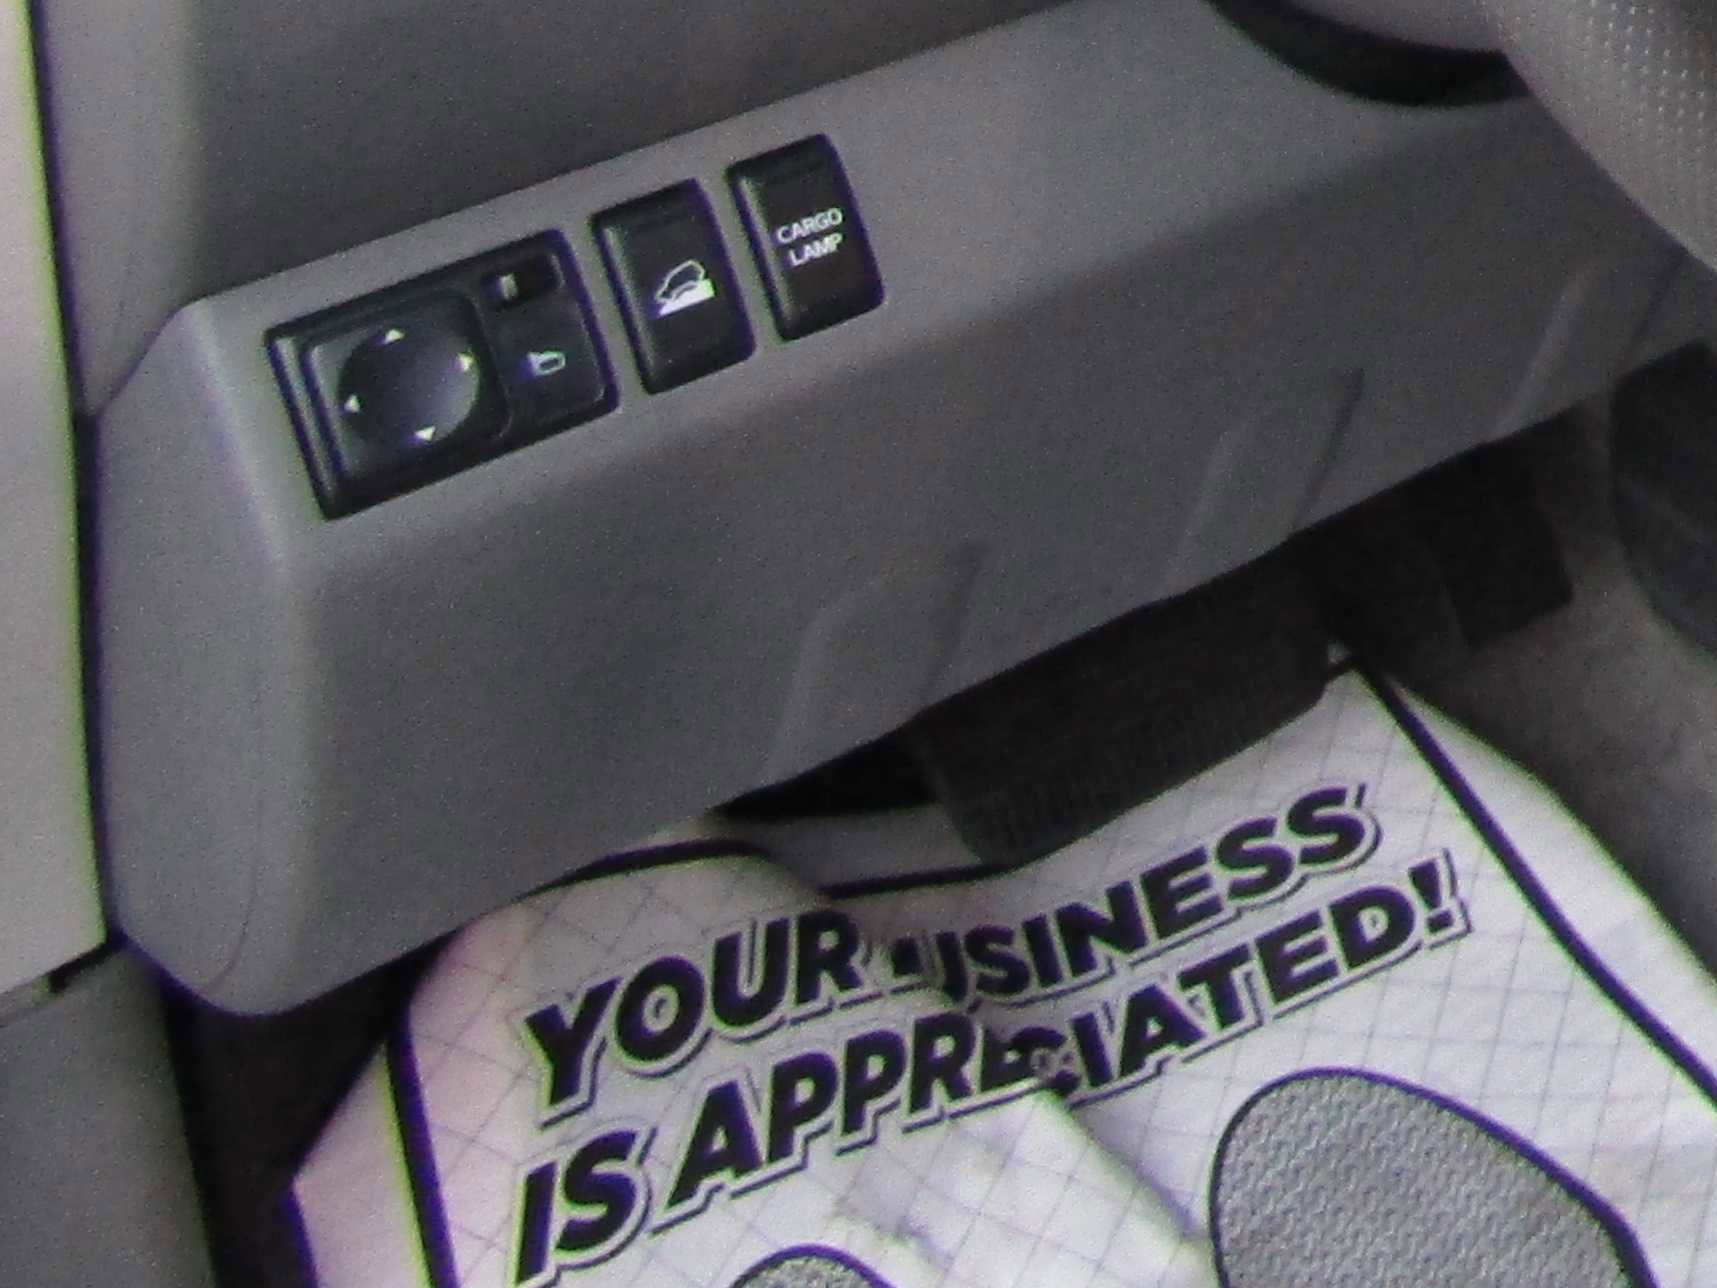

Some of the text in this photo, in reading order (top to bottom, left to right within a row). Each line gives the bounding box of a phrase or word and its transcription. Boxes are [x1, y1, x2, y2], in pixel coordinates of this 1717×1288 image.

[777, 207, 843, 244] CARGO
[789, 232, 843, 266] LAMP
[522, 786, 1376, 1114] YOUR USINESS
[512, 1127, 645, 1288] IS
